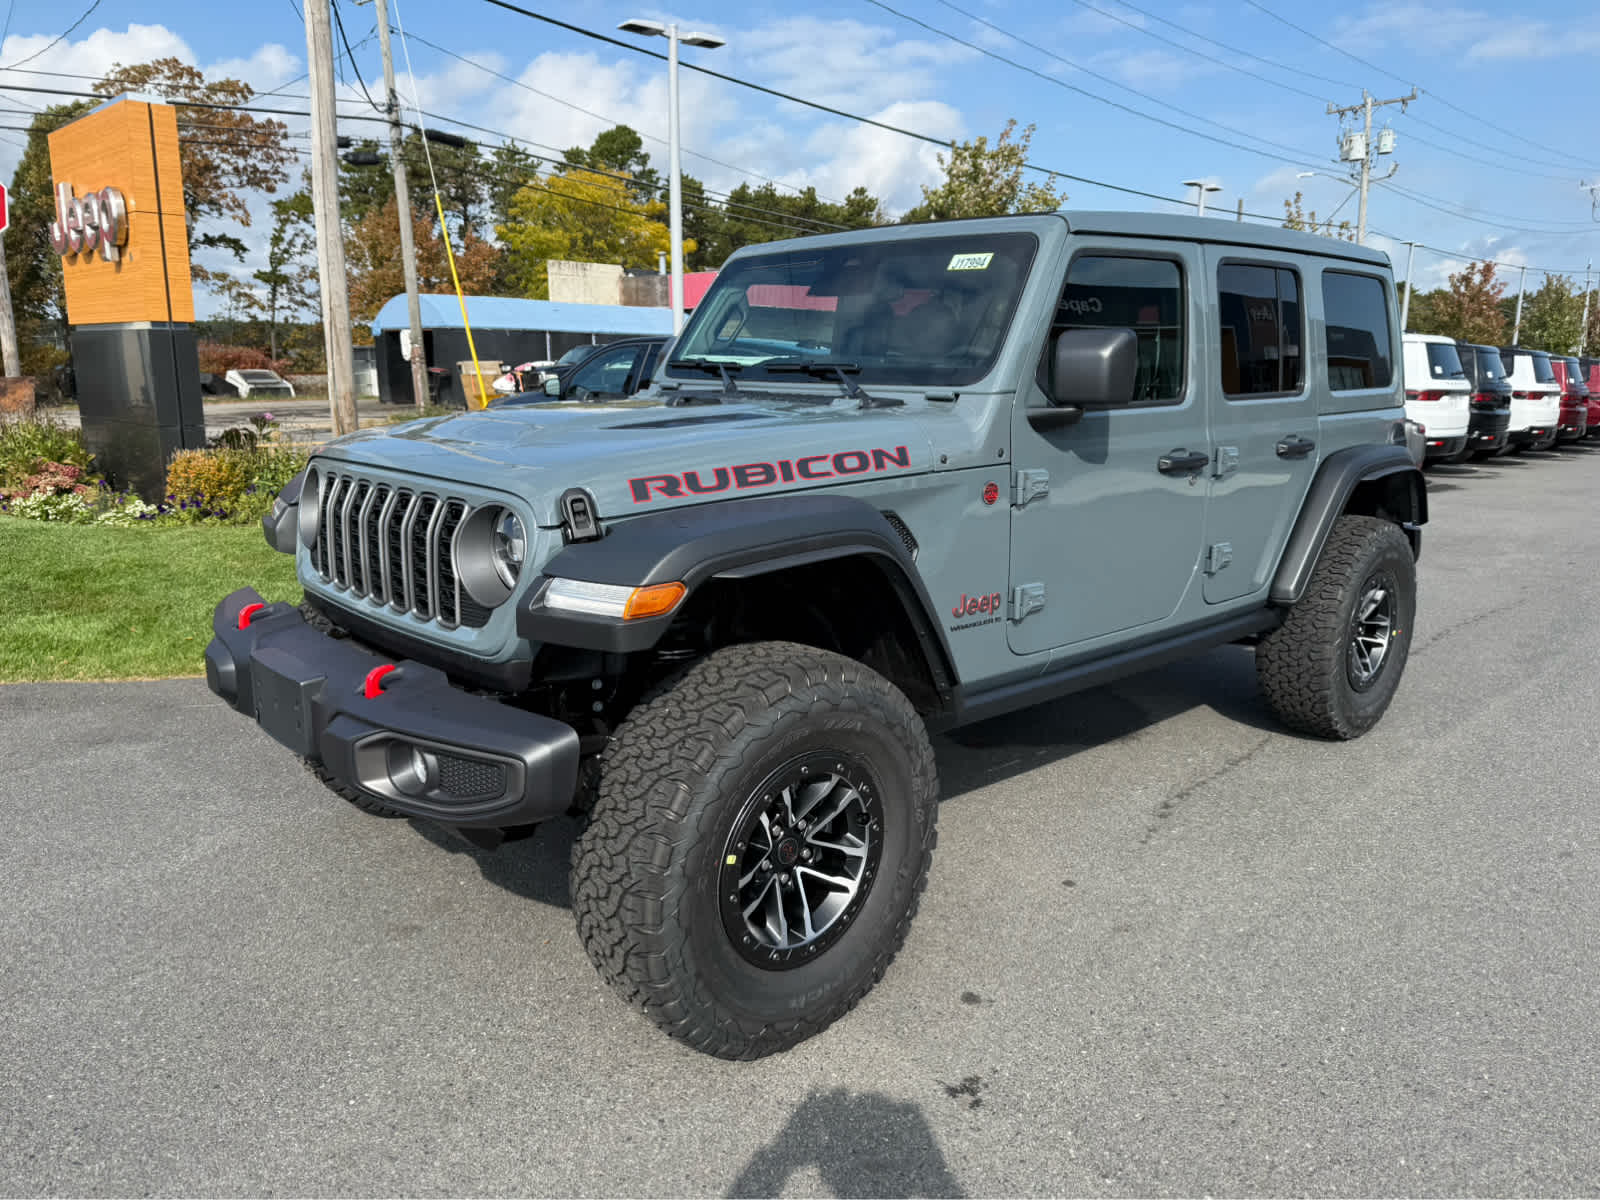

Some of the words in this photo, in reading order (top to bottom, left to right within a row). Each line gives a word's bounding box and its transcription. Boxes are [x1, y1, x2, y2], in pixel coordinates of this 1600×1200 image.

[49, 182, 127, 262] Jeep
[628, 446, 910, 504] RUBICON
[952, 592, 1000, 618] Jeep
